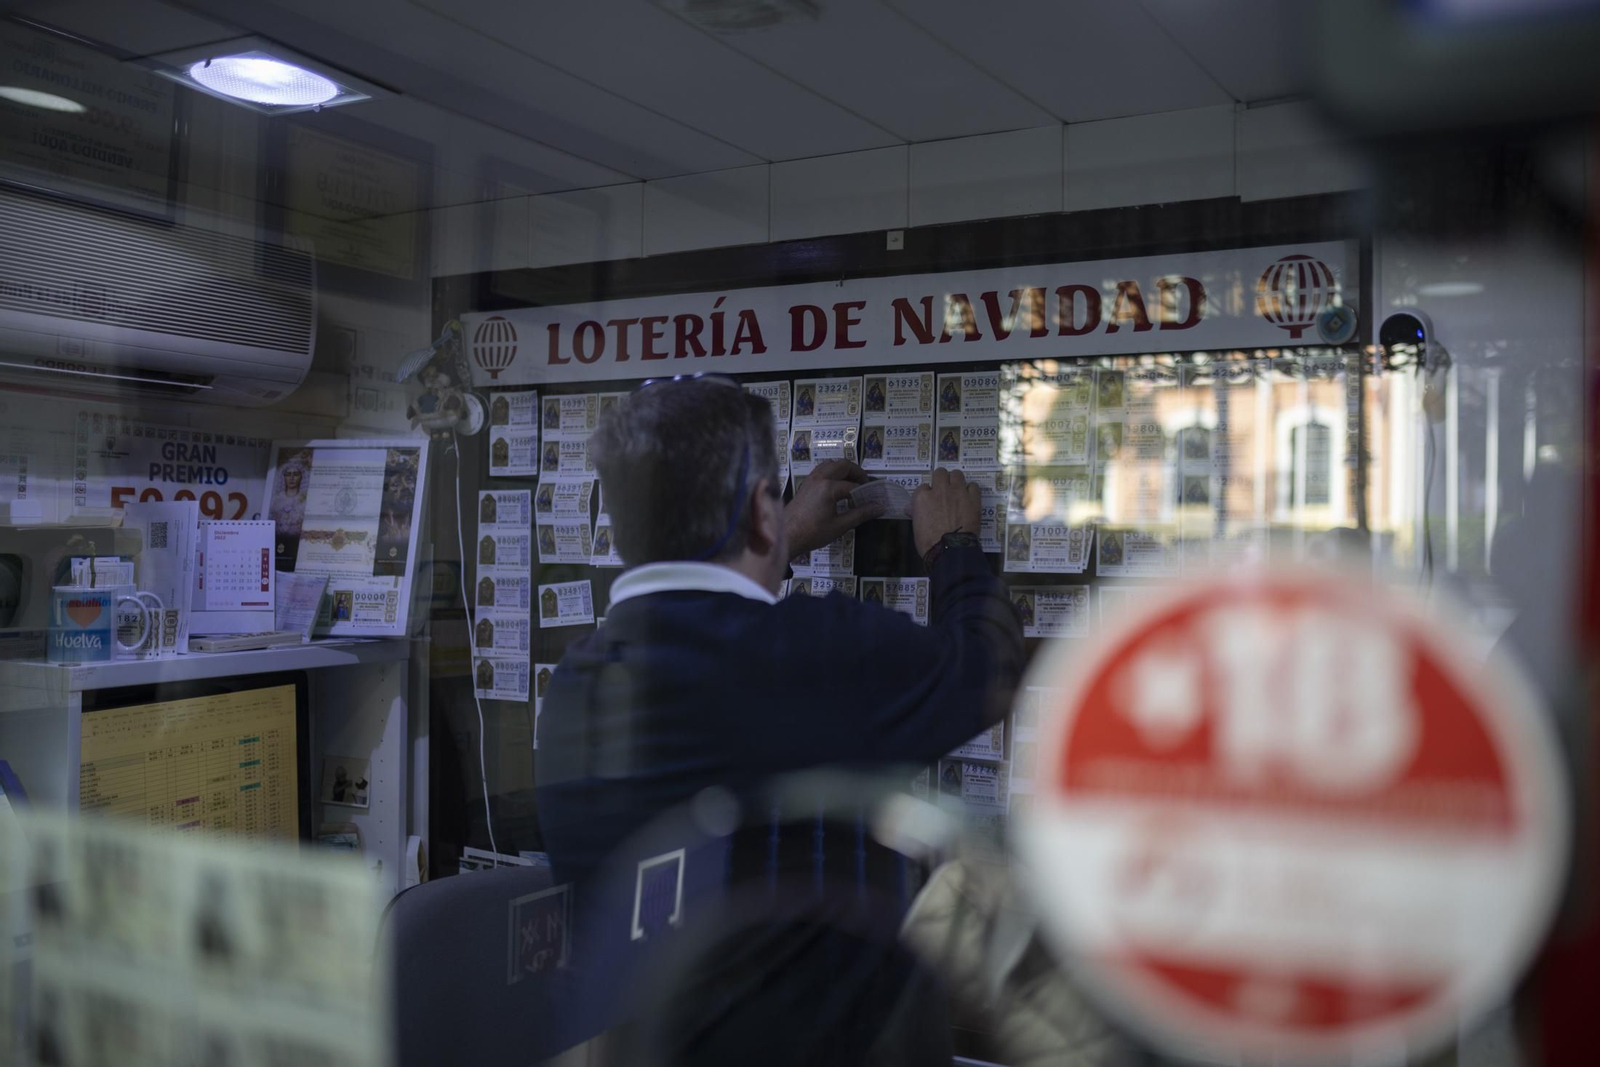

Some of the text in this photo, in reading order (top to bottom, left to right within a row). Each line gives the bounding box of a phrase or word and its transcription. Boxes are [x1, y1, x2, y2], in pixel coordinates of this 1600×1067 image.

[547, 276, 1207, 366] LOTERÍA DE NAVIDAD
[888, 378, 920, 387] 61935
[964, 378, 998, 387] 09086
[818, 384, 848, 393] 23224
[562, 399, 586, 408] 46391
[814, 430, 844, 439] 23224
[886, 427, 918, 436] 61935
[963, 428, 997, 437] 09086
[561, 441, 585, 450] 46391
[162, 442, 216, 464] GRAN
[149, 462, 229, 486] PREMIO
[557, 484, 581, 493] 46391
[556, 525, 580, 534] 46391
[1033, 526, 1068, 536] 71007
[813, 581, 844, 589] 32534
[886, 584, 916, 593] 57885
[355, 593, 386, 601] 00000
[55, 632, 102, 650] Huelva
